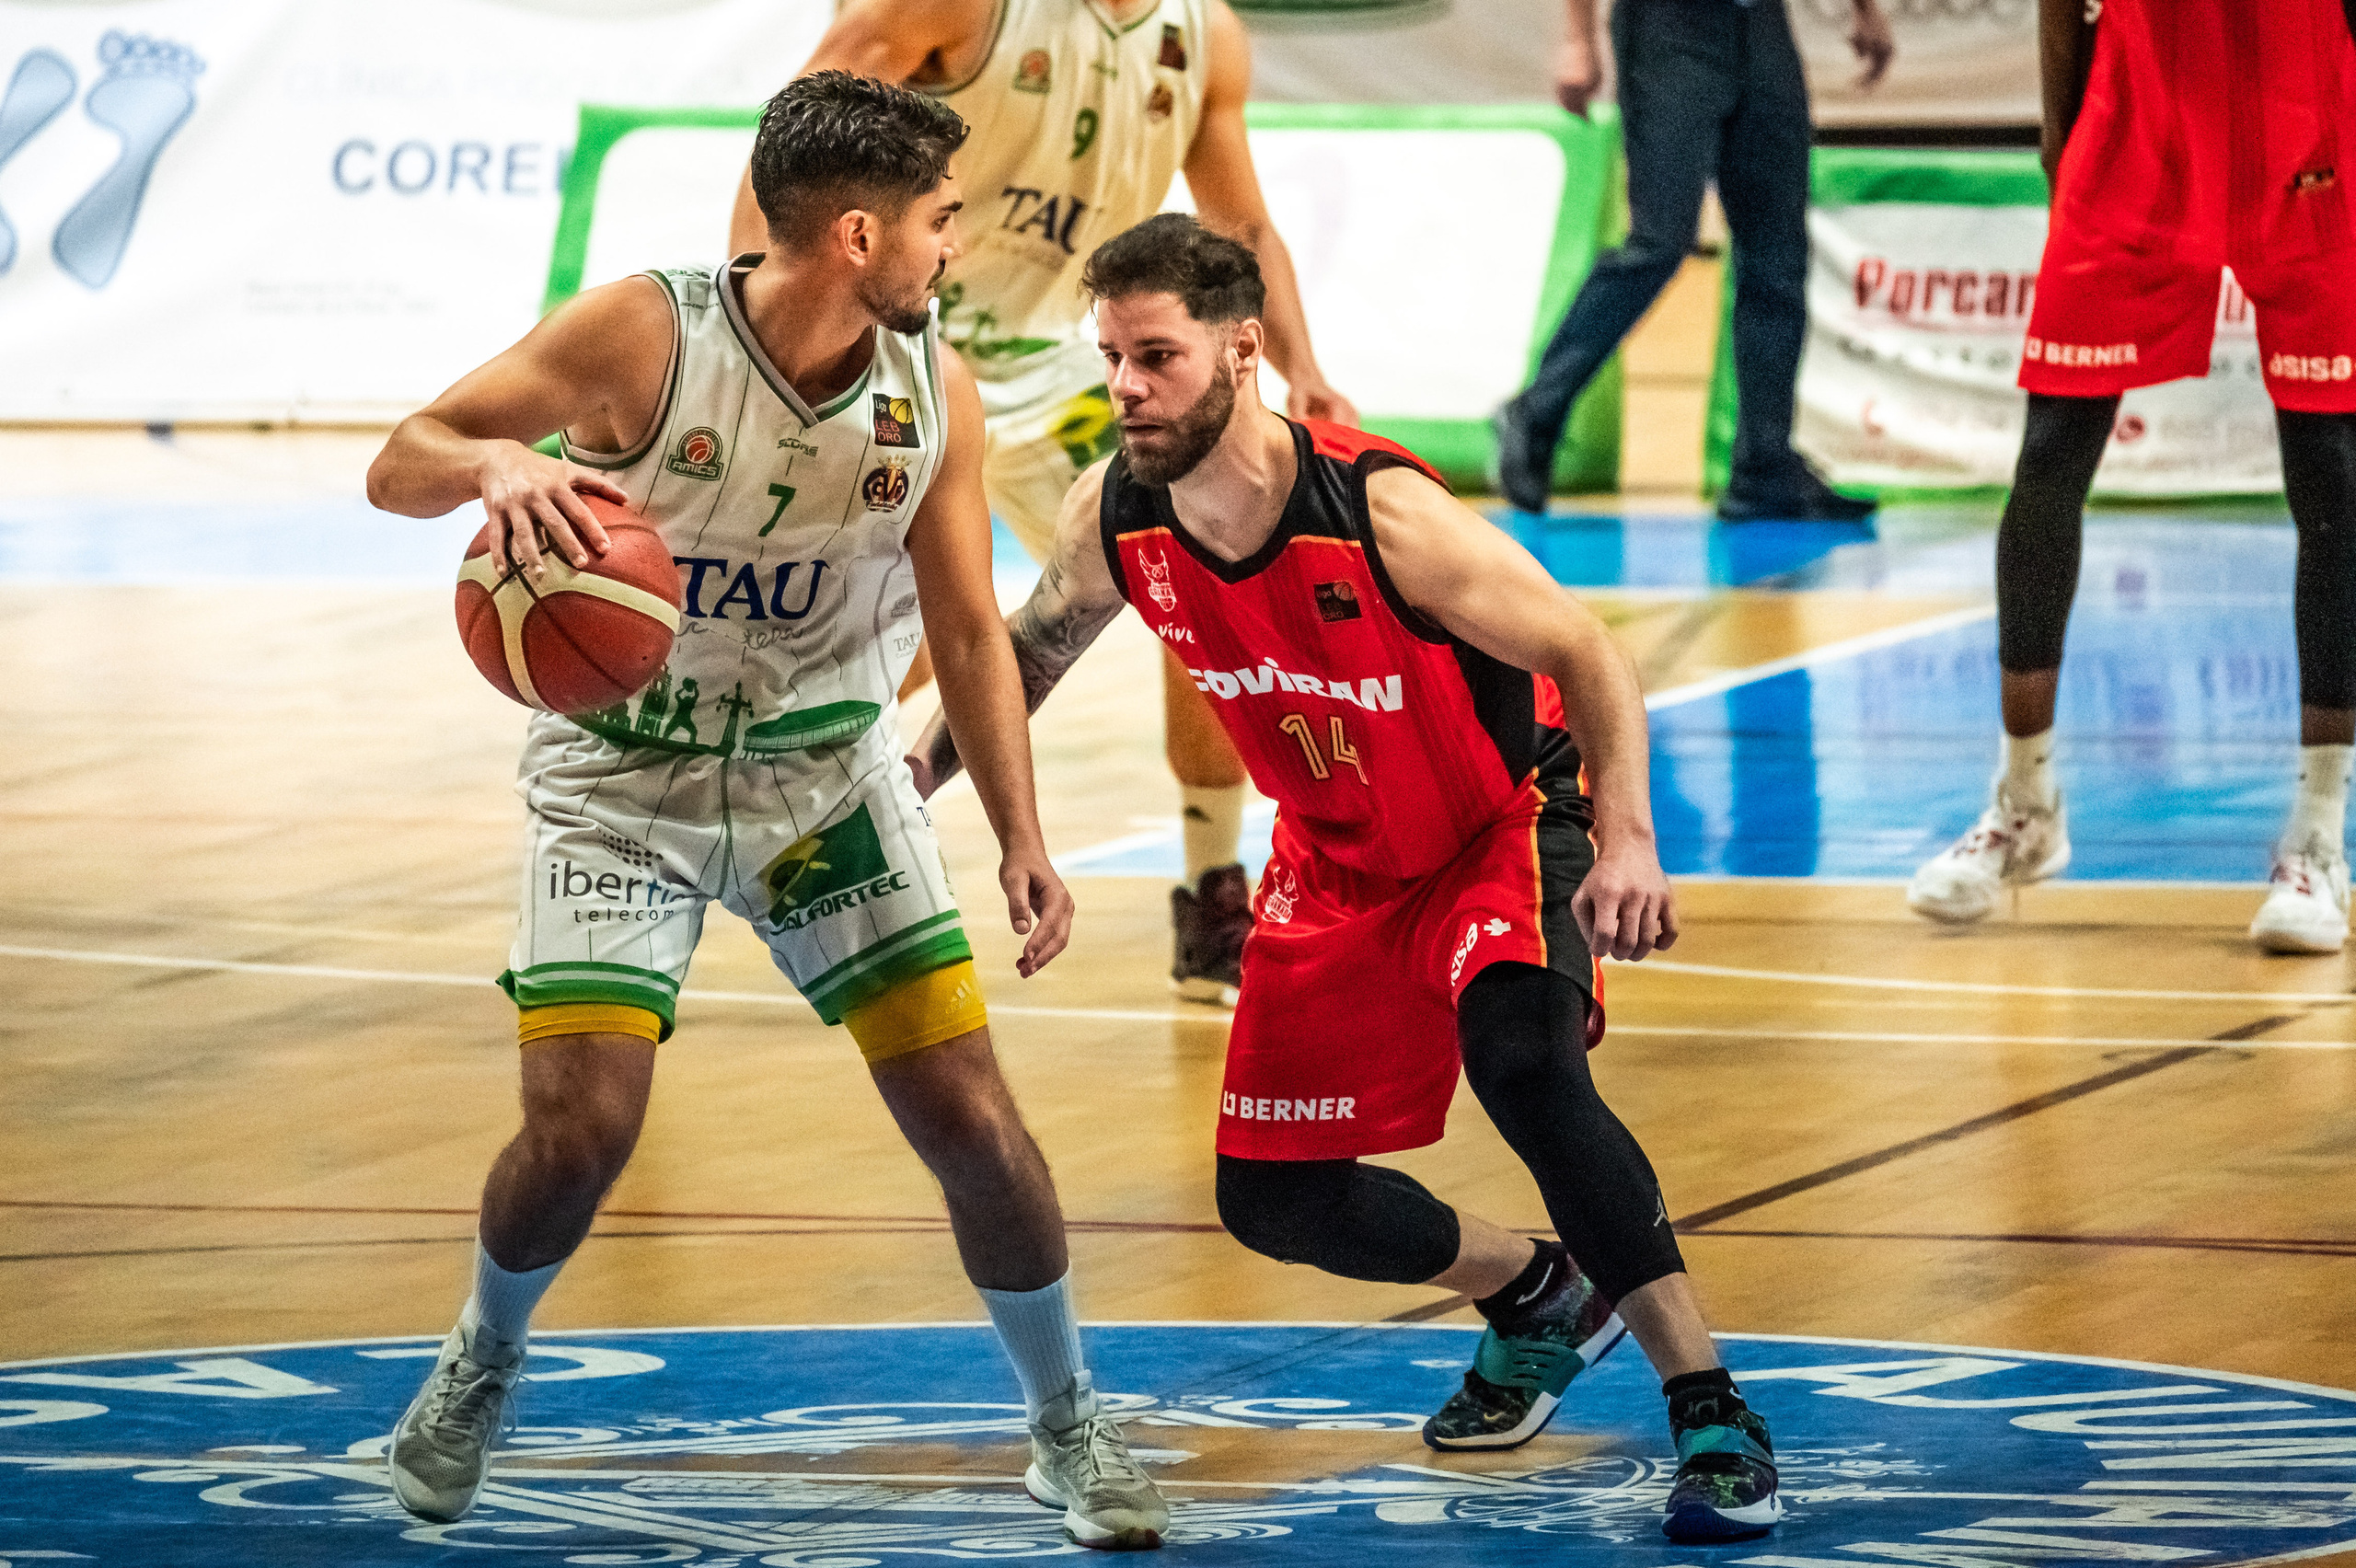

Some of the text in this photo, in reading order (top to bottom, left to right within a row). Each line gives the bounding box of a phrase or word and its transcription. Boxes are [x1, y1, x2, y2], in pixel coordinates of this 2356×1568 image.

[1070, 107, 1099, 161] 9
[331, 136, 572, 196] CORE
[875, 420, 900, 432] LEB
[877, 432, 902, 443] ORO
[673, 461, 718, 477] AMICS
[758, 482, 797, 537] 7
[672, 556, 830, 620] TAU
[1279, 713, 1369, 786] 14
[573, 907, 675, 924] telecom
[770, 870, 910, 935] ALFORTEC
[1240, 1095, 1357, 1122] BERNER
